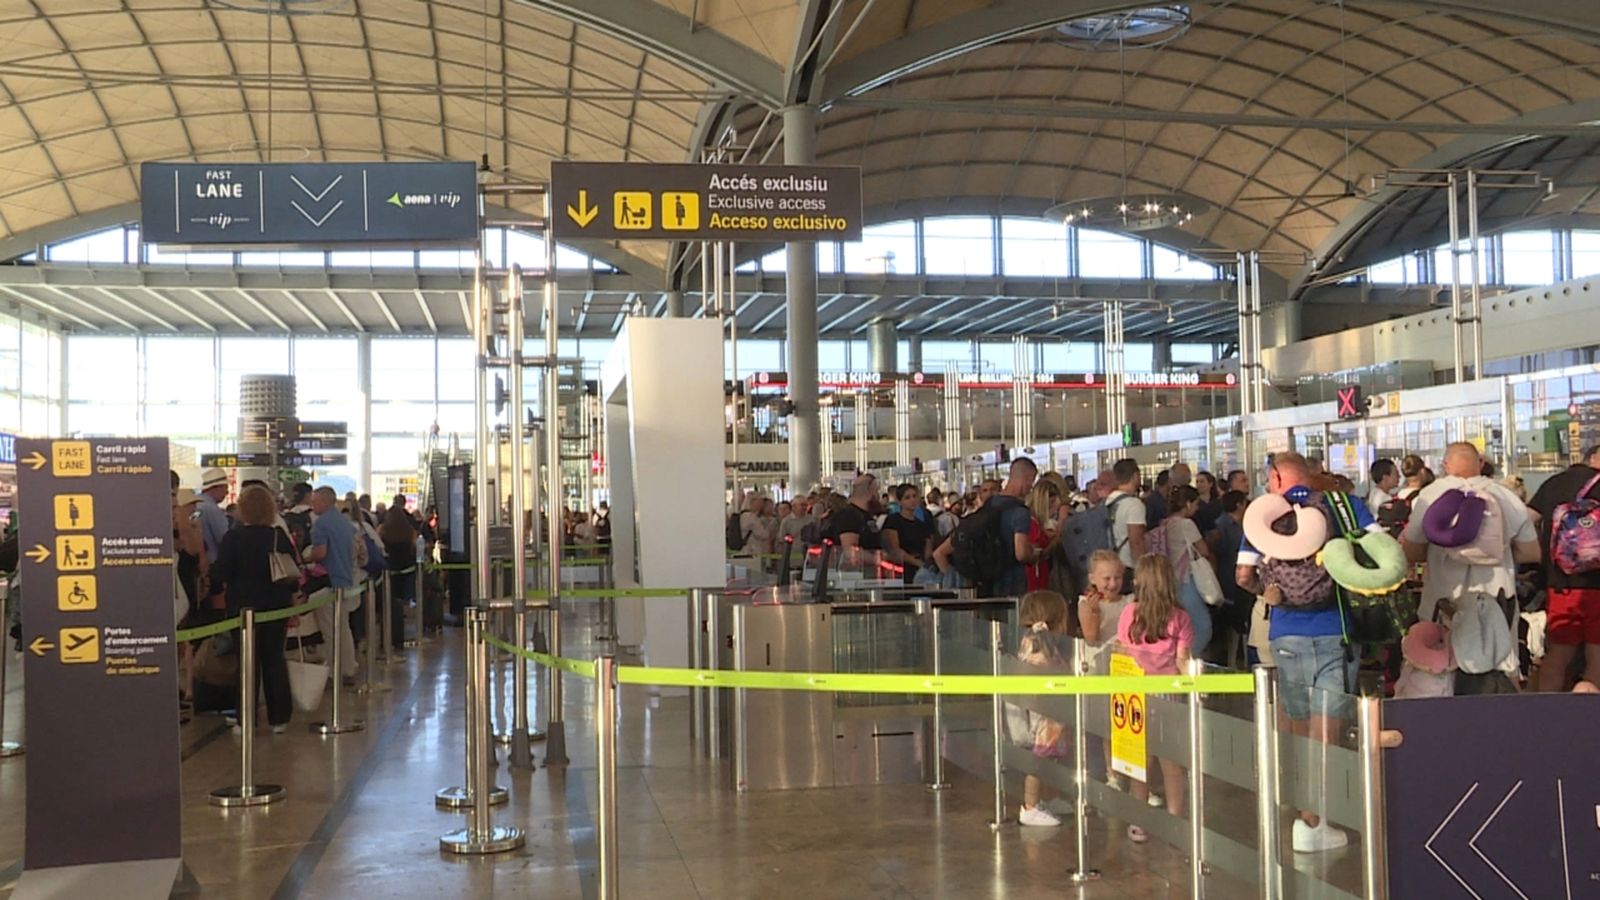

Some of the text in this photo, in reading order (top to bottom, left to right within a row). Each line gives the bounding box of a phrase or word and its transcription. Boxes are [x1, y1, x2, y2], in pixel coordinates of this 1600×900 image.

[206, 170, 232, 180] FAST
[709, 173, 828, 192] Accés exclusiu
[196, 183, 243, 198] LANE
[404, 191, 461, 208] aena vip
[708, 194, 826, 211] Exclusive access
[209, 212, 232, 230] vip
[709, 212, 847, 231] Acceso exclusivo
[1124, 373, 1199, 385] BURGER KING
[58, 447, 84, 457] FAST
[96, 444, 122, 454] Carril
[58, 460, 86, 470] LANE
[97, 465, 122, 473] Carril
[102, 557, 134, 565] Acceso
